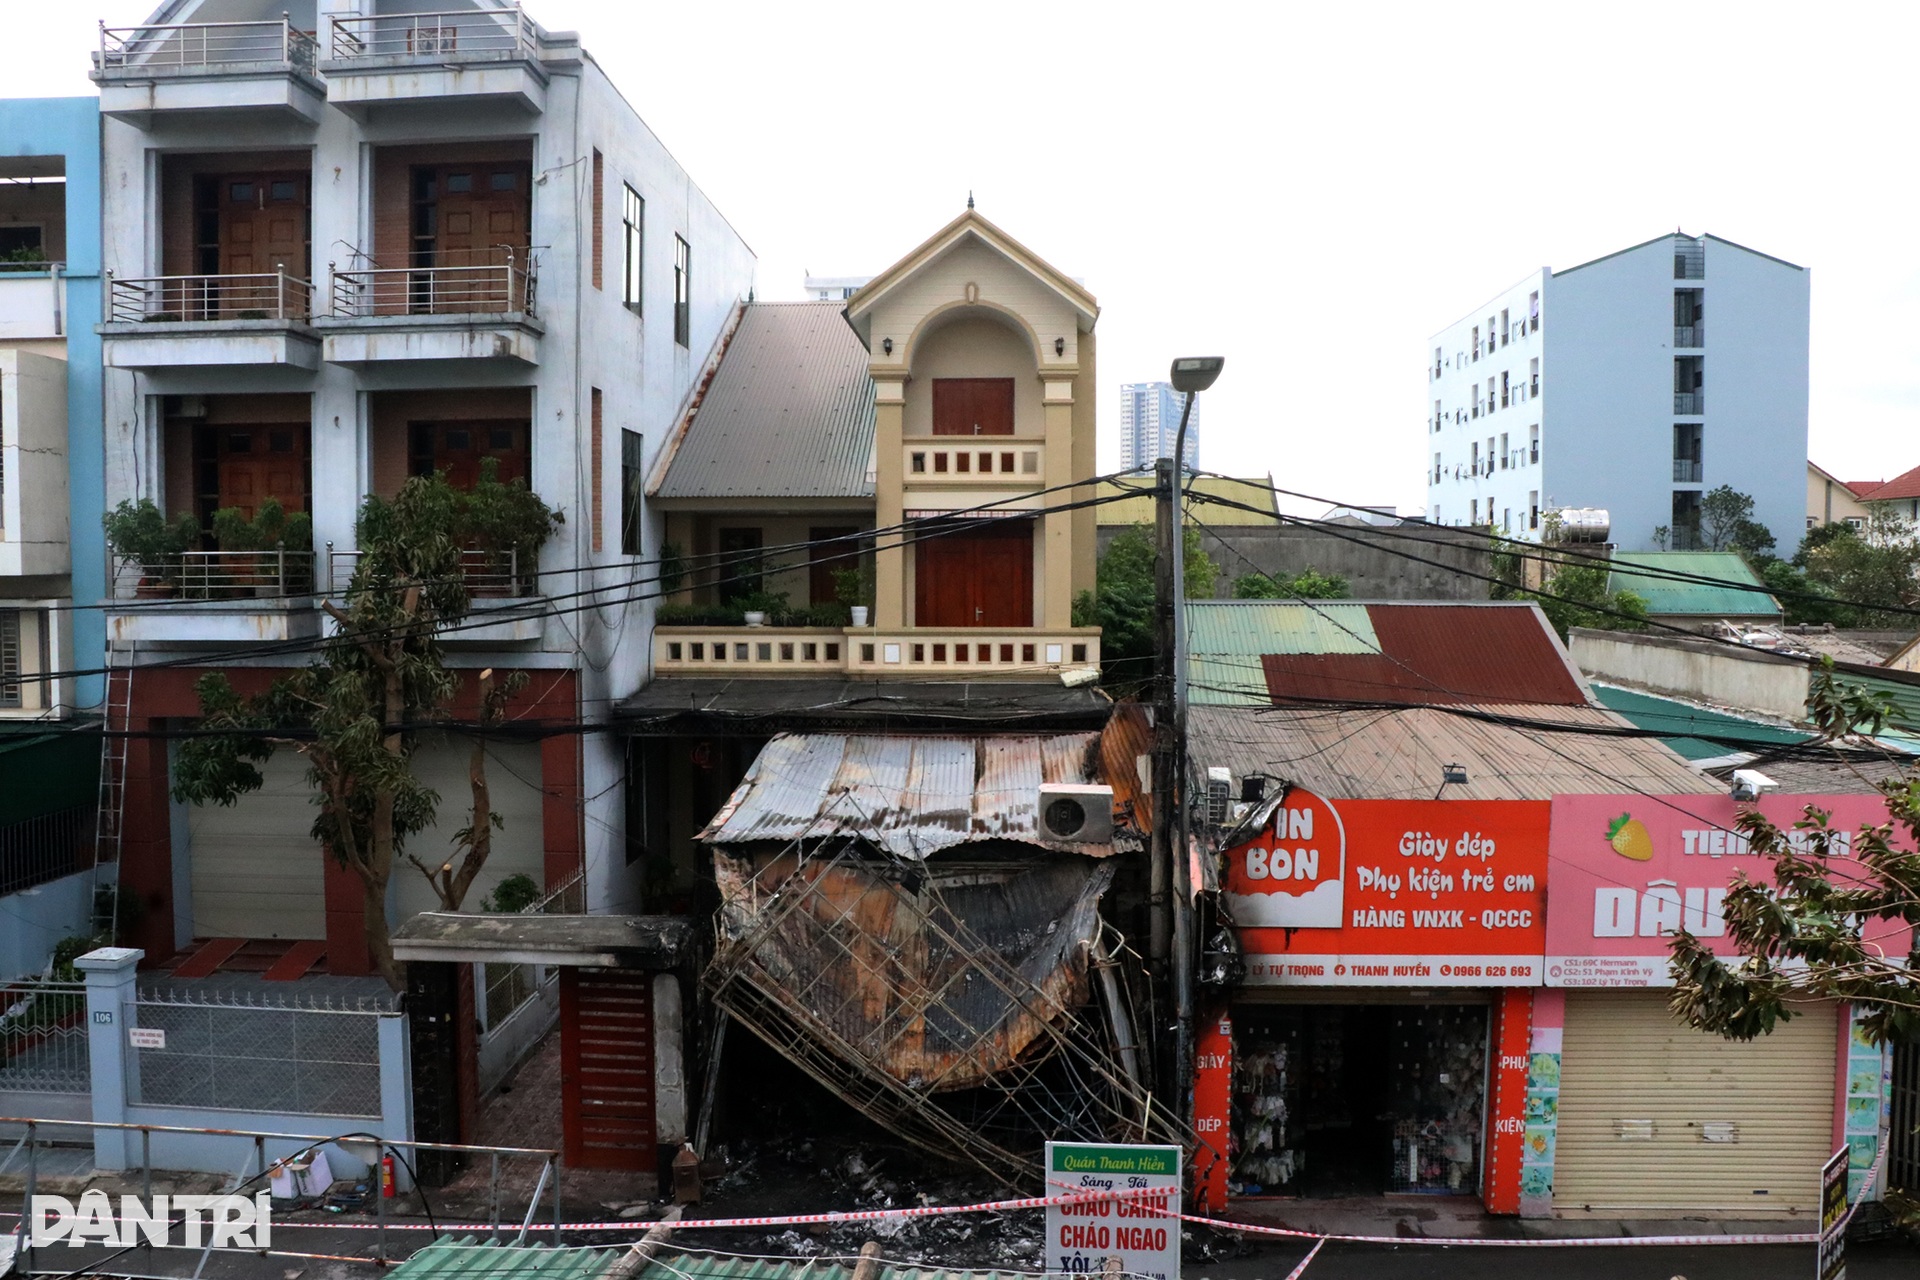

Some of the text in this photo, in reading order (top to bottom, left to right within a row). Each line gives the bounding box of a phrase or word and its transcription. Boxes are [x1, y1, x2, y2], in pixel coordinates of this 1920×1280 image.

[1398, 831, 1496, 863] Giày dép
[1246, 847, 1319, 881] BON
[1356, 866, 1535, 900] Phụ kiện trẻ em
[1593, 878, 1727, 938] DÂU
[1352, 905, 1405, 928] HÀNG
[1412, 909, 1464, 928] VNXK
[1481, 909, 1532, 929] QCCC
[1269, 964, 1284, 978] TỰ
[1288, 965, 1324, 978] TRỌNG
[1351, 965, 1389, 976] THANH
[1393, 962, 1431, 977] HUYỀN
[1453, 966, 1481, 977] 0966
[1485, 966, 1506, 977] 626
[1510, 966, 1532, 977] 693
[1600, 959, 1637, 967] Hermann
[95, 1012, 111, 1023] 106
[1197, 1052, 1225, 1069] GIÀY
[1502, 1056, 1526, 1072] PHỤ
[1198, 1116, 1222, 1132] DÉP
[1496, 1117, 1525, 1135] KIỆN
[1064, 1155, 1165, 1171] Quán Thanh Hiền
[1080, 1175, 1114, 1191] Sáng
[1127, 1176, 1149, 1188] Tối
[1060, 1221, 1167, 1251] CHÁO NGAO
[1060, 1250, 1090, 1276] XÔI
